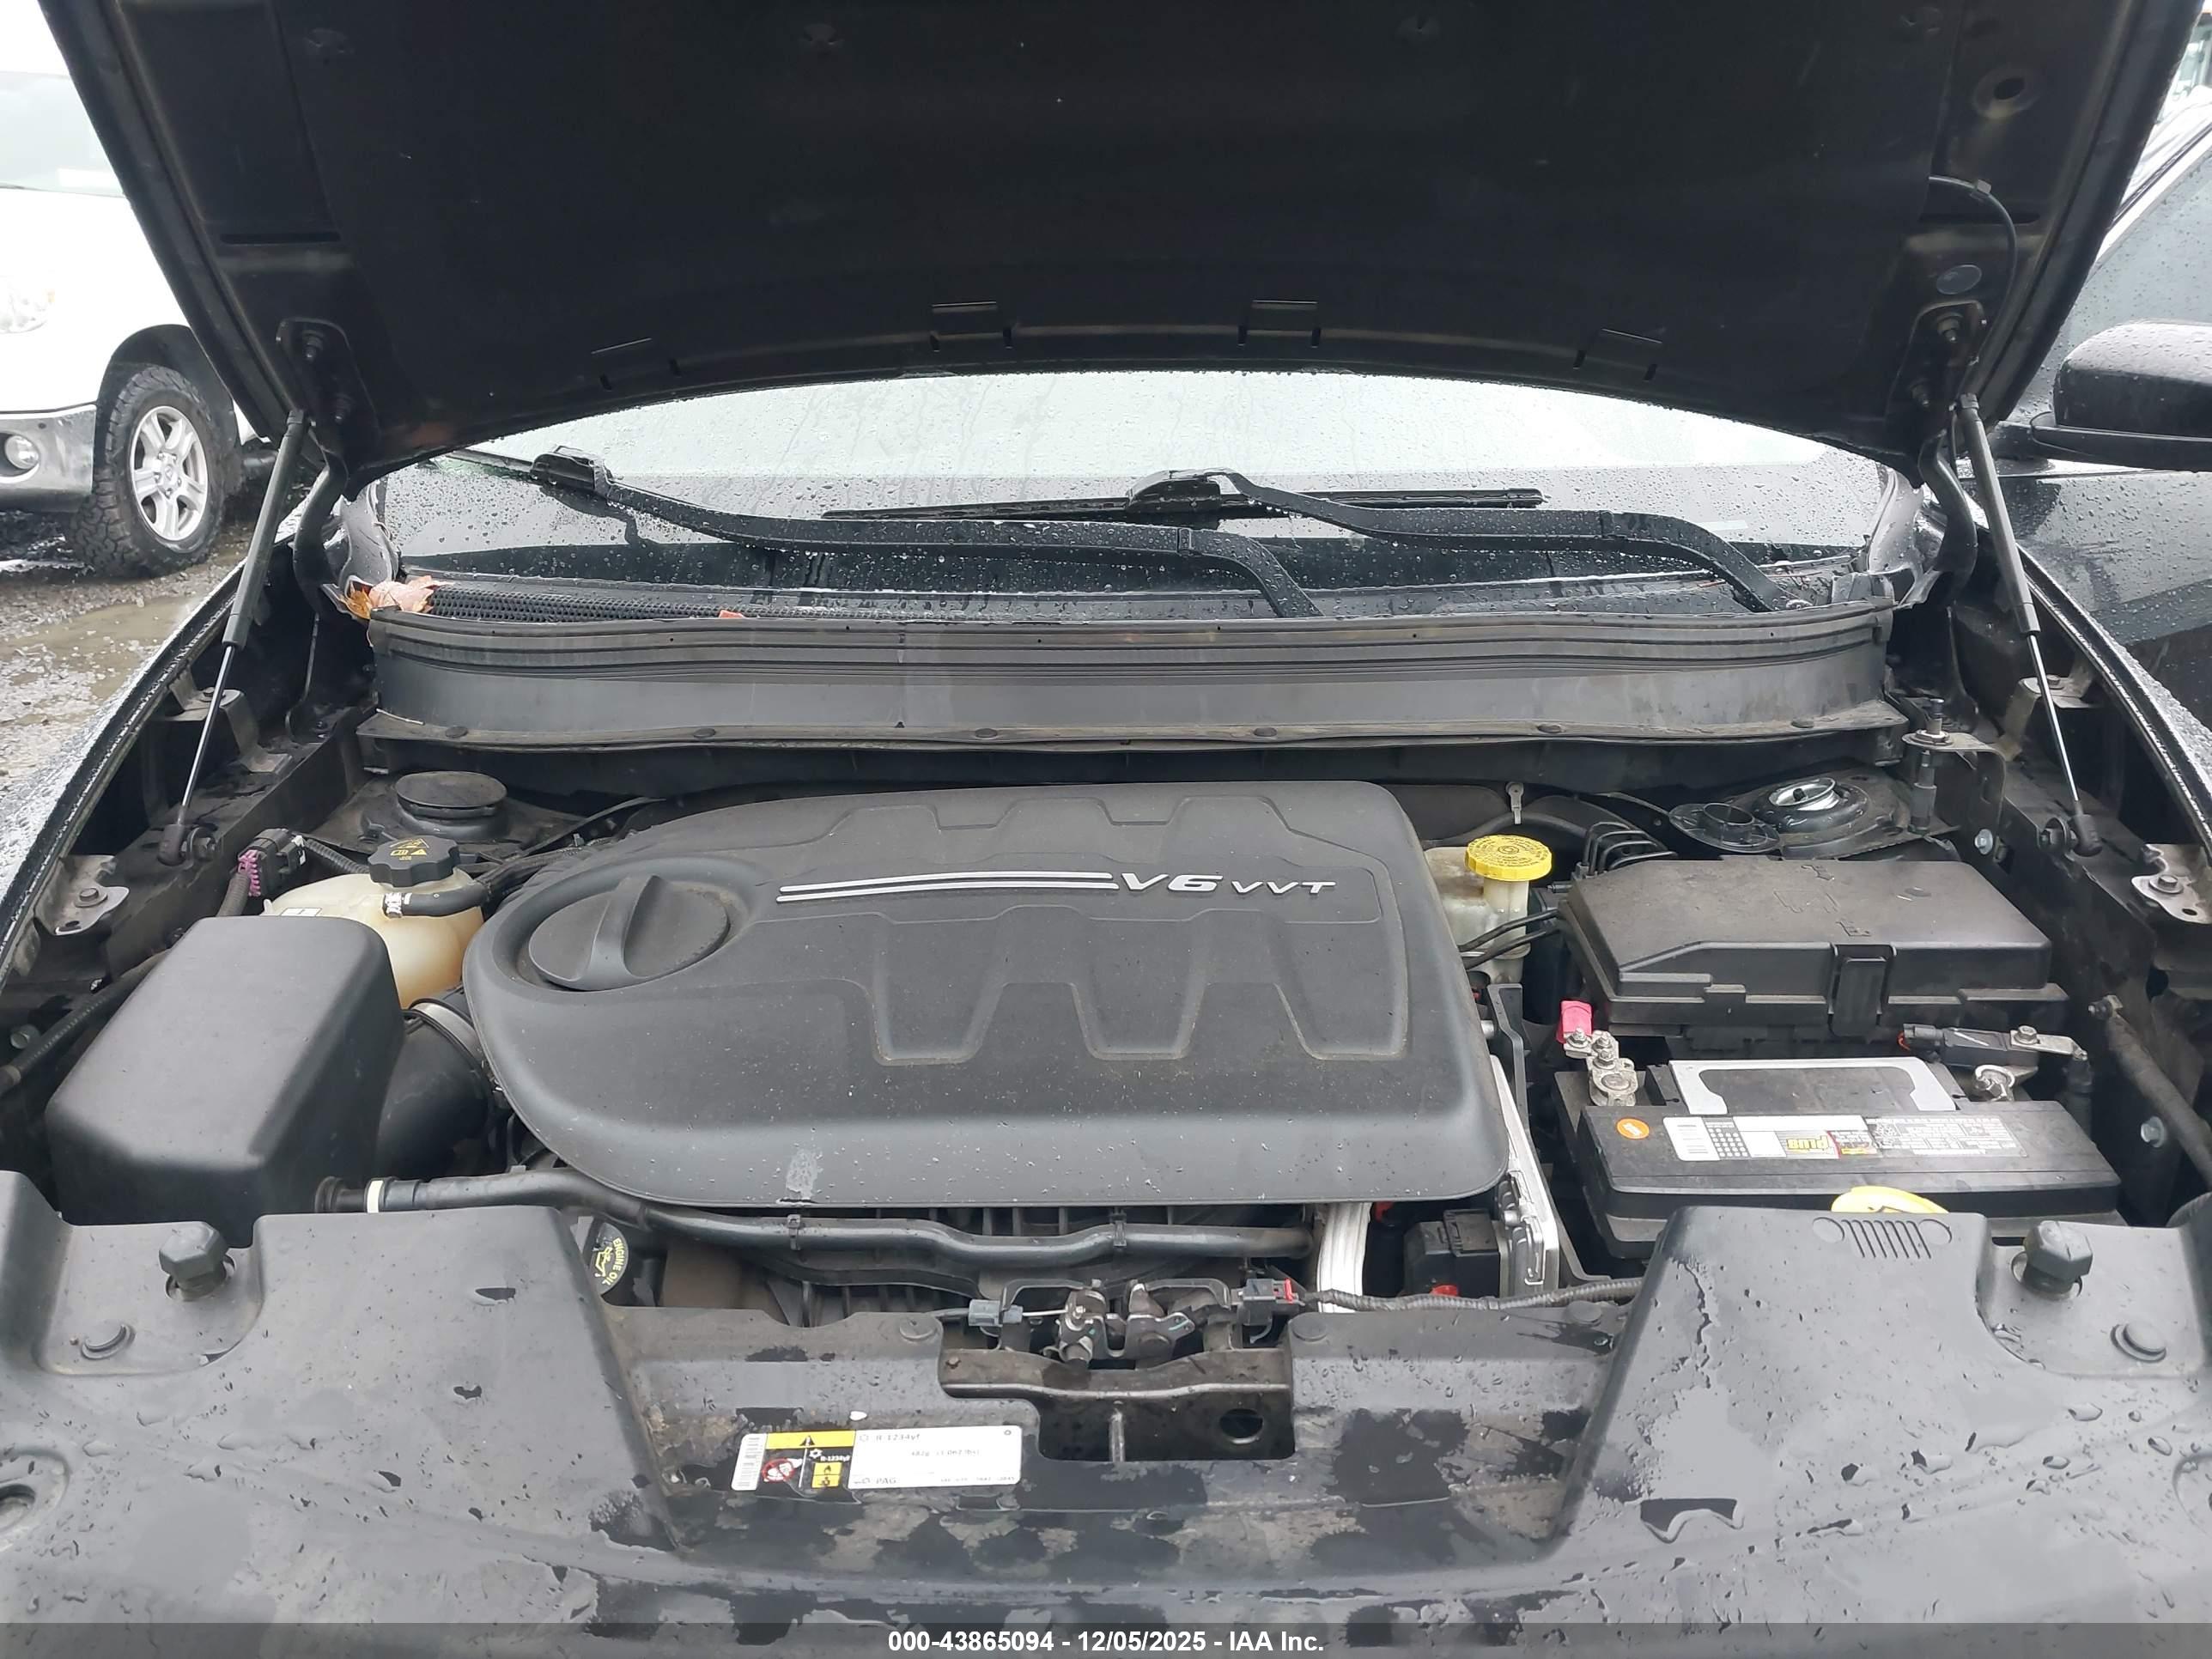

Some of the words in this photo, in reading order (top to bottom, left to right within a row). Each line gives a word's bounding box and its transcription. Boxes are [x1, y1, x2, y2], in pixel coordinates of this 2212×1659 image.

[1121, 872, 1224, 892] V6
[1231, 881, 1336, 894] VVT
[612, 1237, 625, 1271] ENGINE
[602, 1272, 617, 1285] OIL
